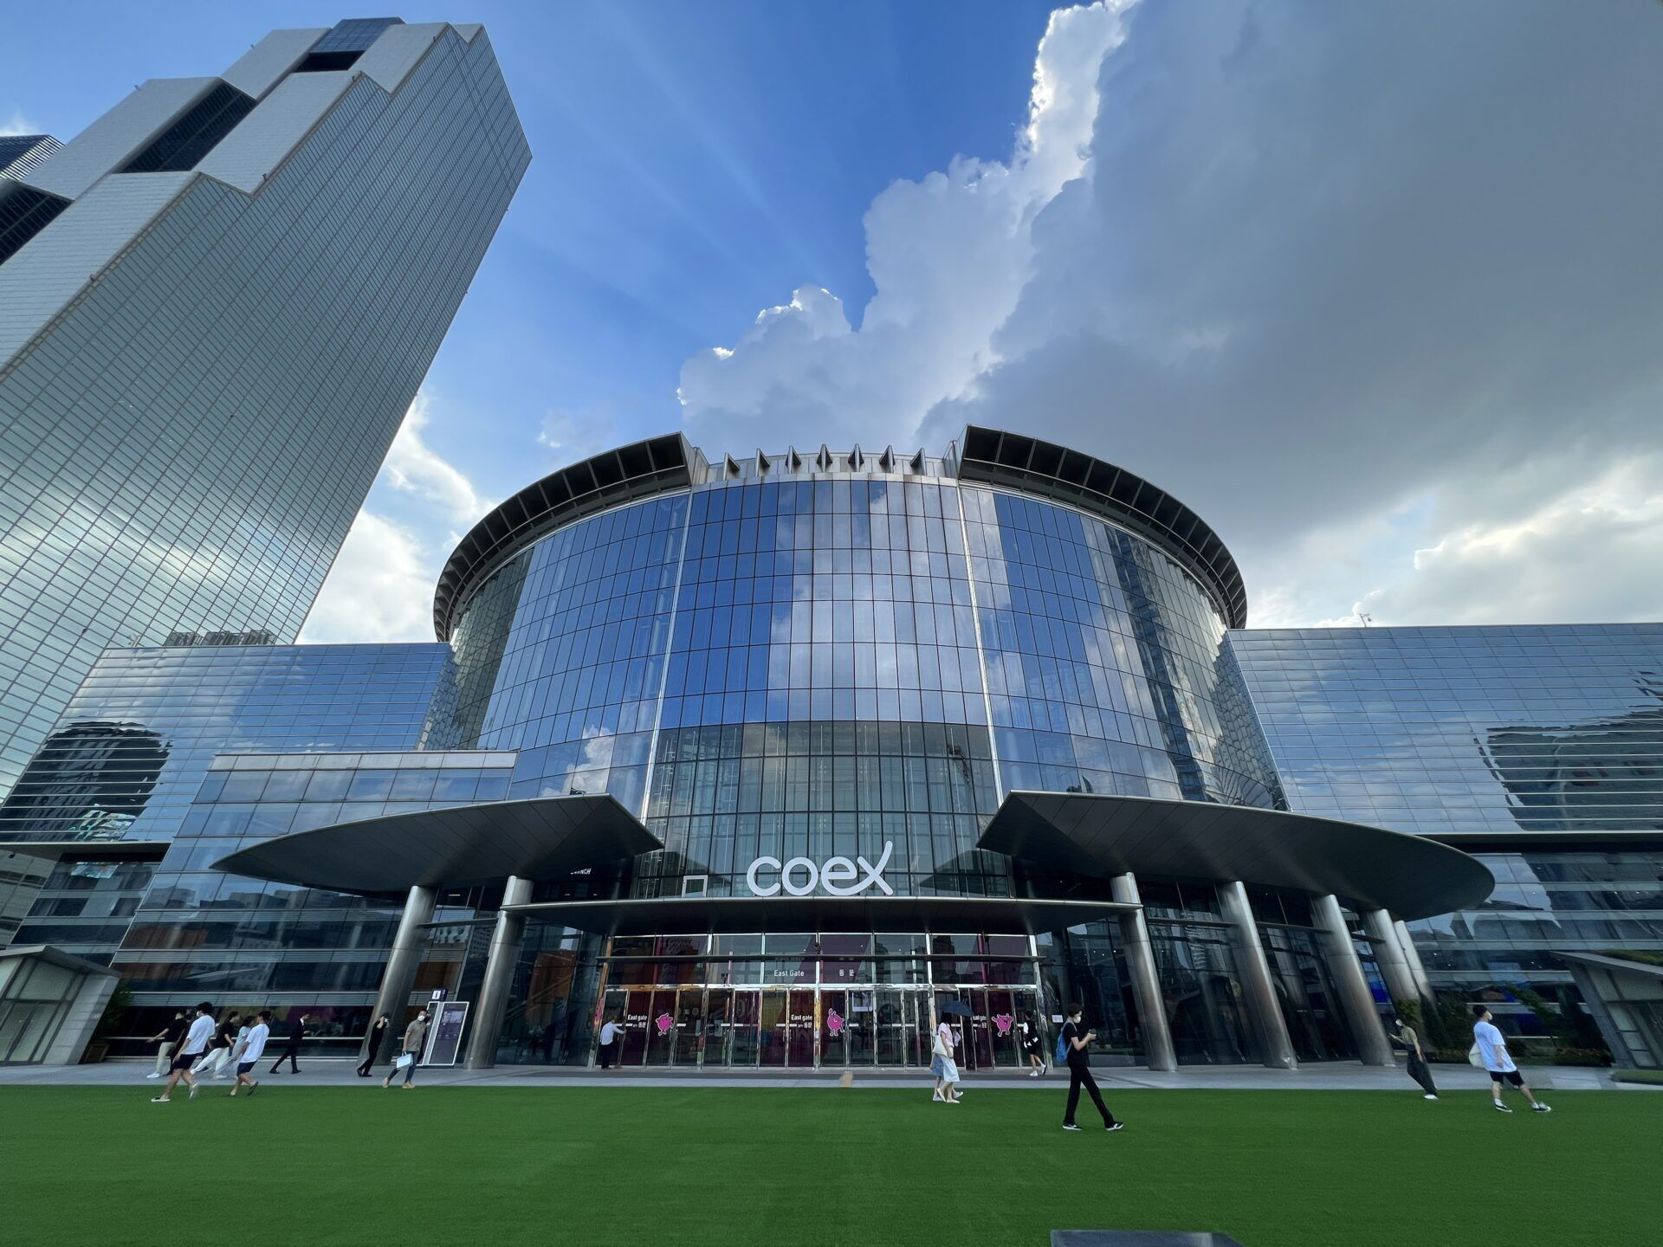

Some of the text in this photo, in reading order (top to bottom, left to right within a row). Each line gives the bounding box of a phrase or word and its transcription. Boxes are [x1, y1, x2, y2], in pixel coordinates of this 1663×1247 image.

[746, 840, 894, 896] coex
[773, 969, 805, 977] East Gate
[801, 1014, 813, 1022] gate
